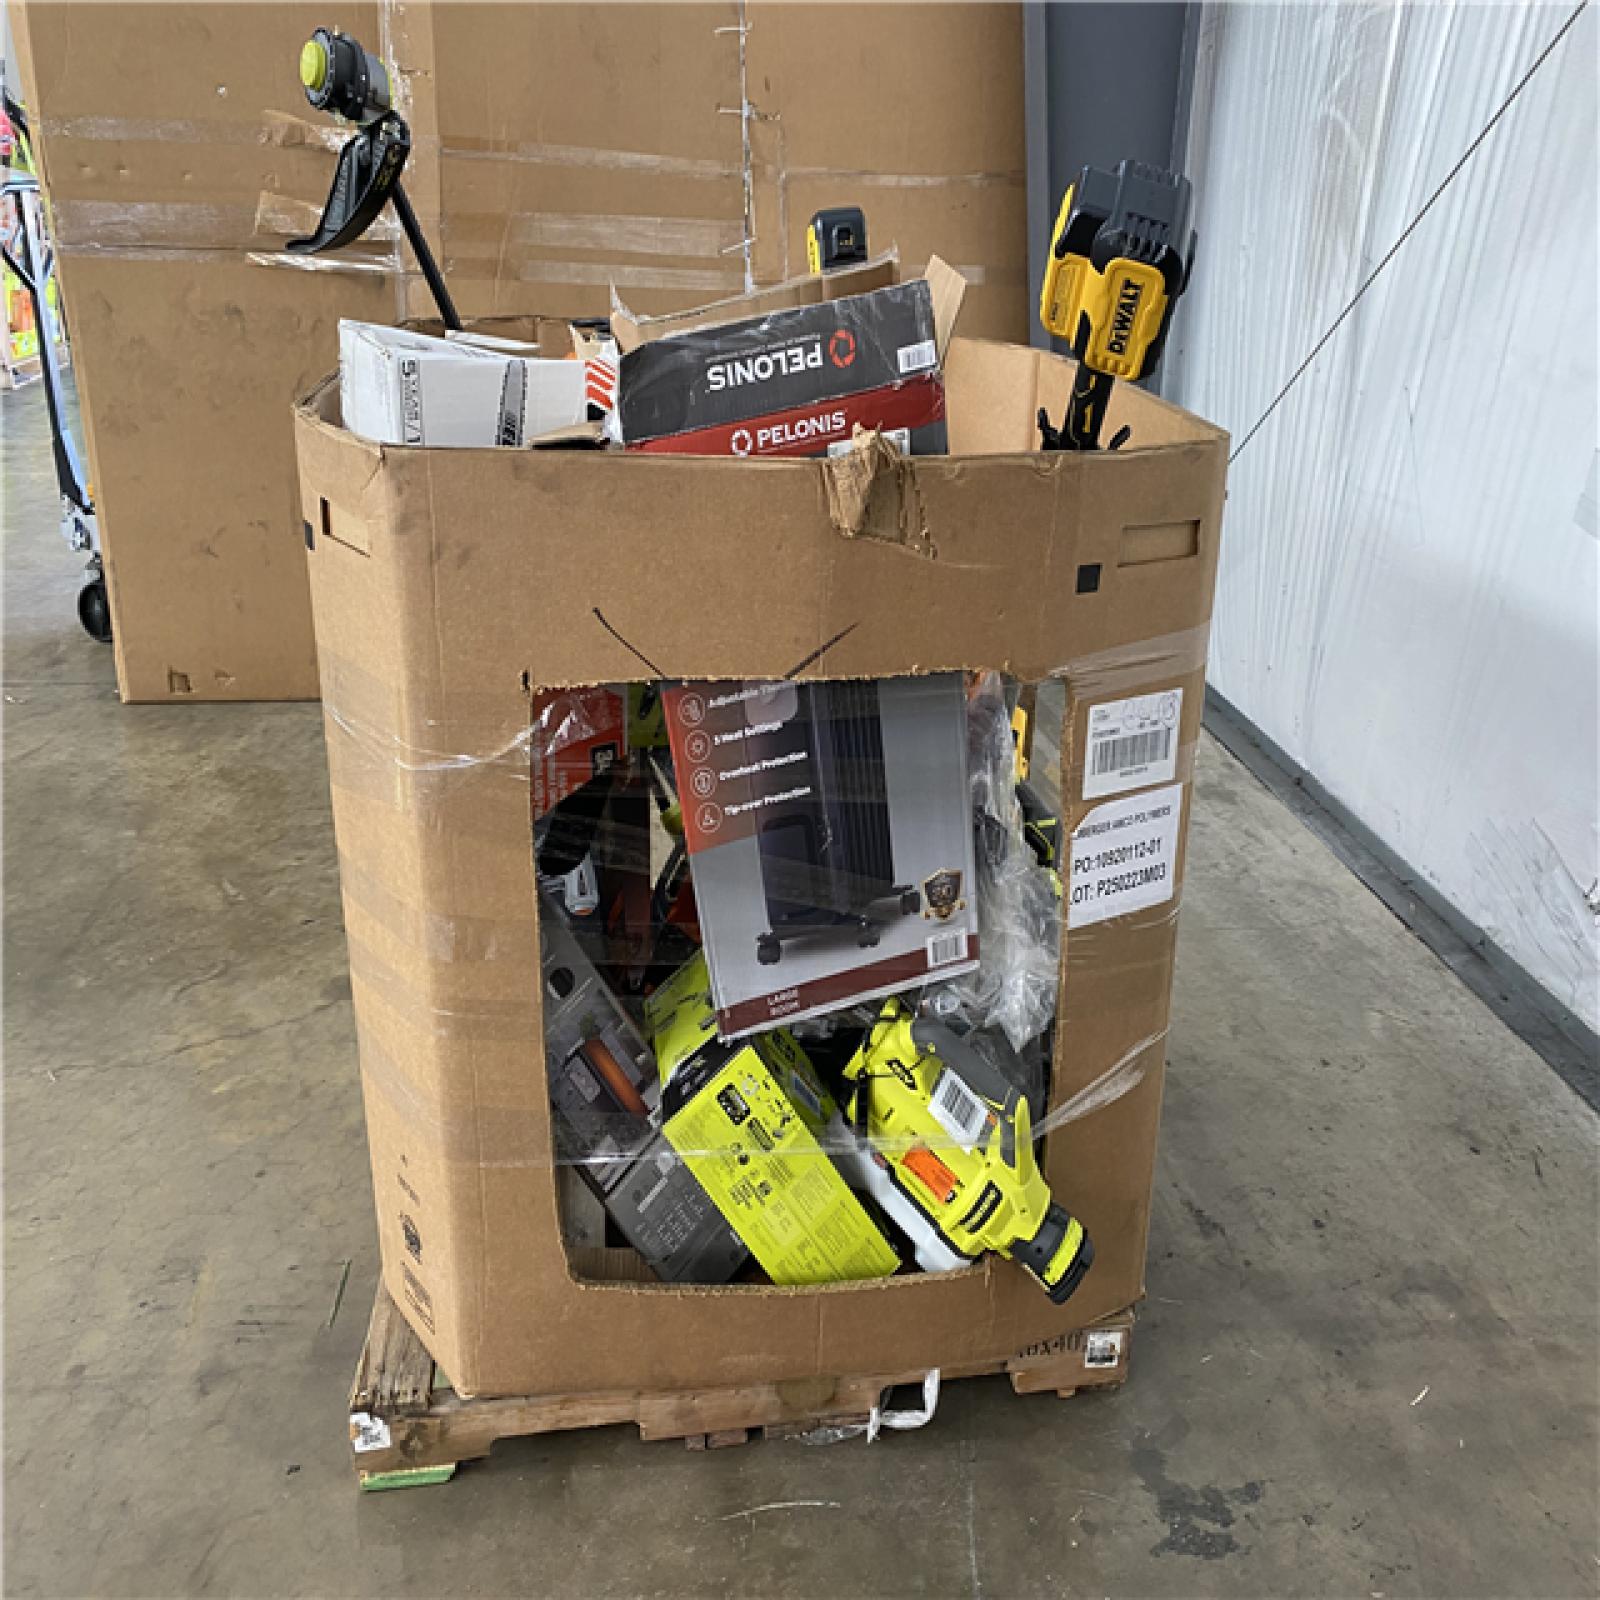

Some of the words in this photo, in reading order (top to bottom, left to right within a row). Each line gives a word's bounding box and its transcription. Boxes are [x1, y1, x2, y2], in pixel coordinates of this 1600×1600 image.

[1107, 278, 1143, 354] DEWALT
[706, 342, 823, 391] PELONIS
[757, 410, 846, 448] PELONIS
[1070, 882, 1094, 906] OT:
